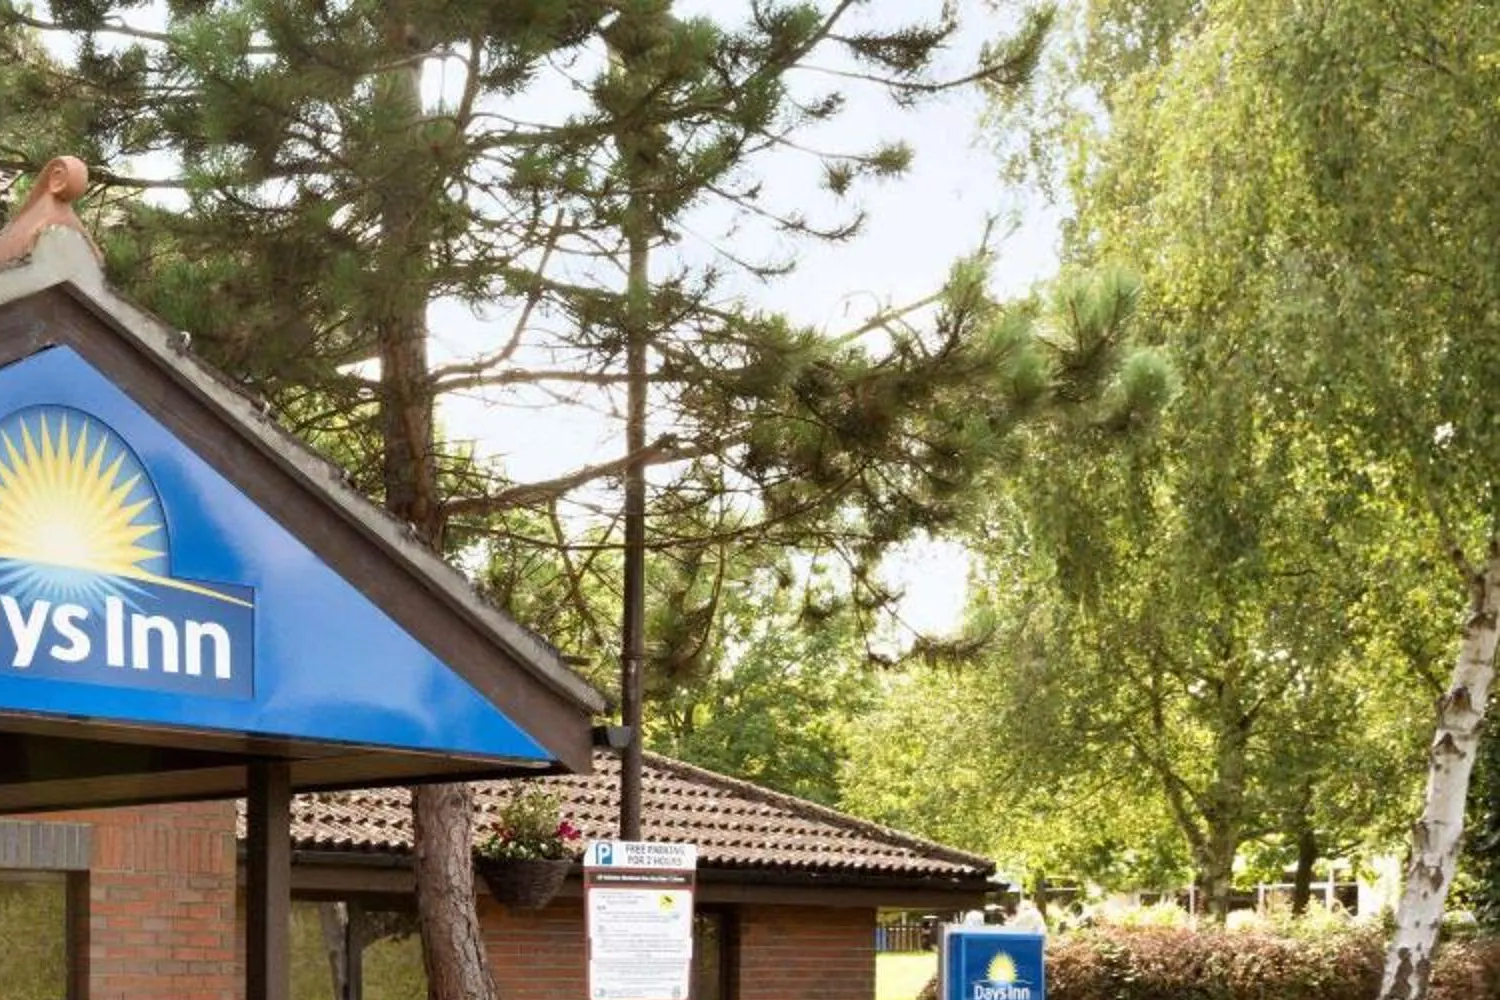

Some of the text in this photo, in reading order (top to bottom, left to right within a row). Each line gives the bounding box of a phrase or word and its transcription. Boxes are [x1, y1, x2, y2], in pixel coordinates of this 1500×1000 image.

[106, 595, 231, 679] Inn
[625, 843, 645, 854] FREE
[1007, 985, 1031, 1000] Inn
